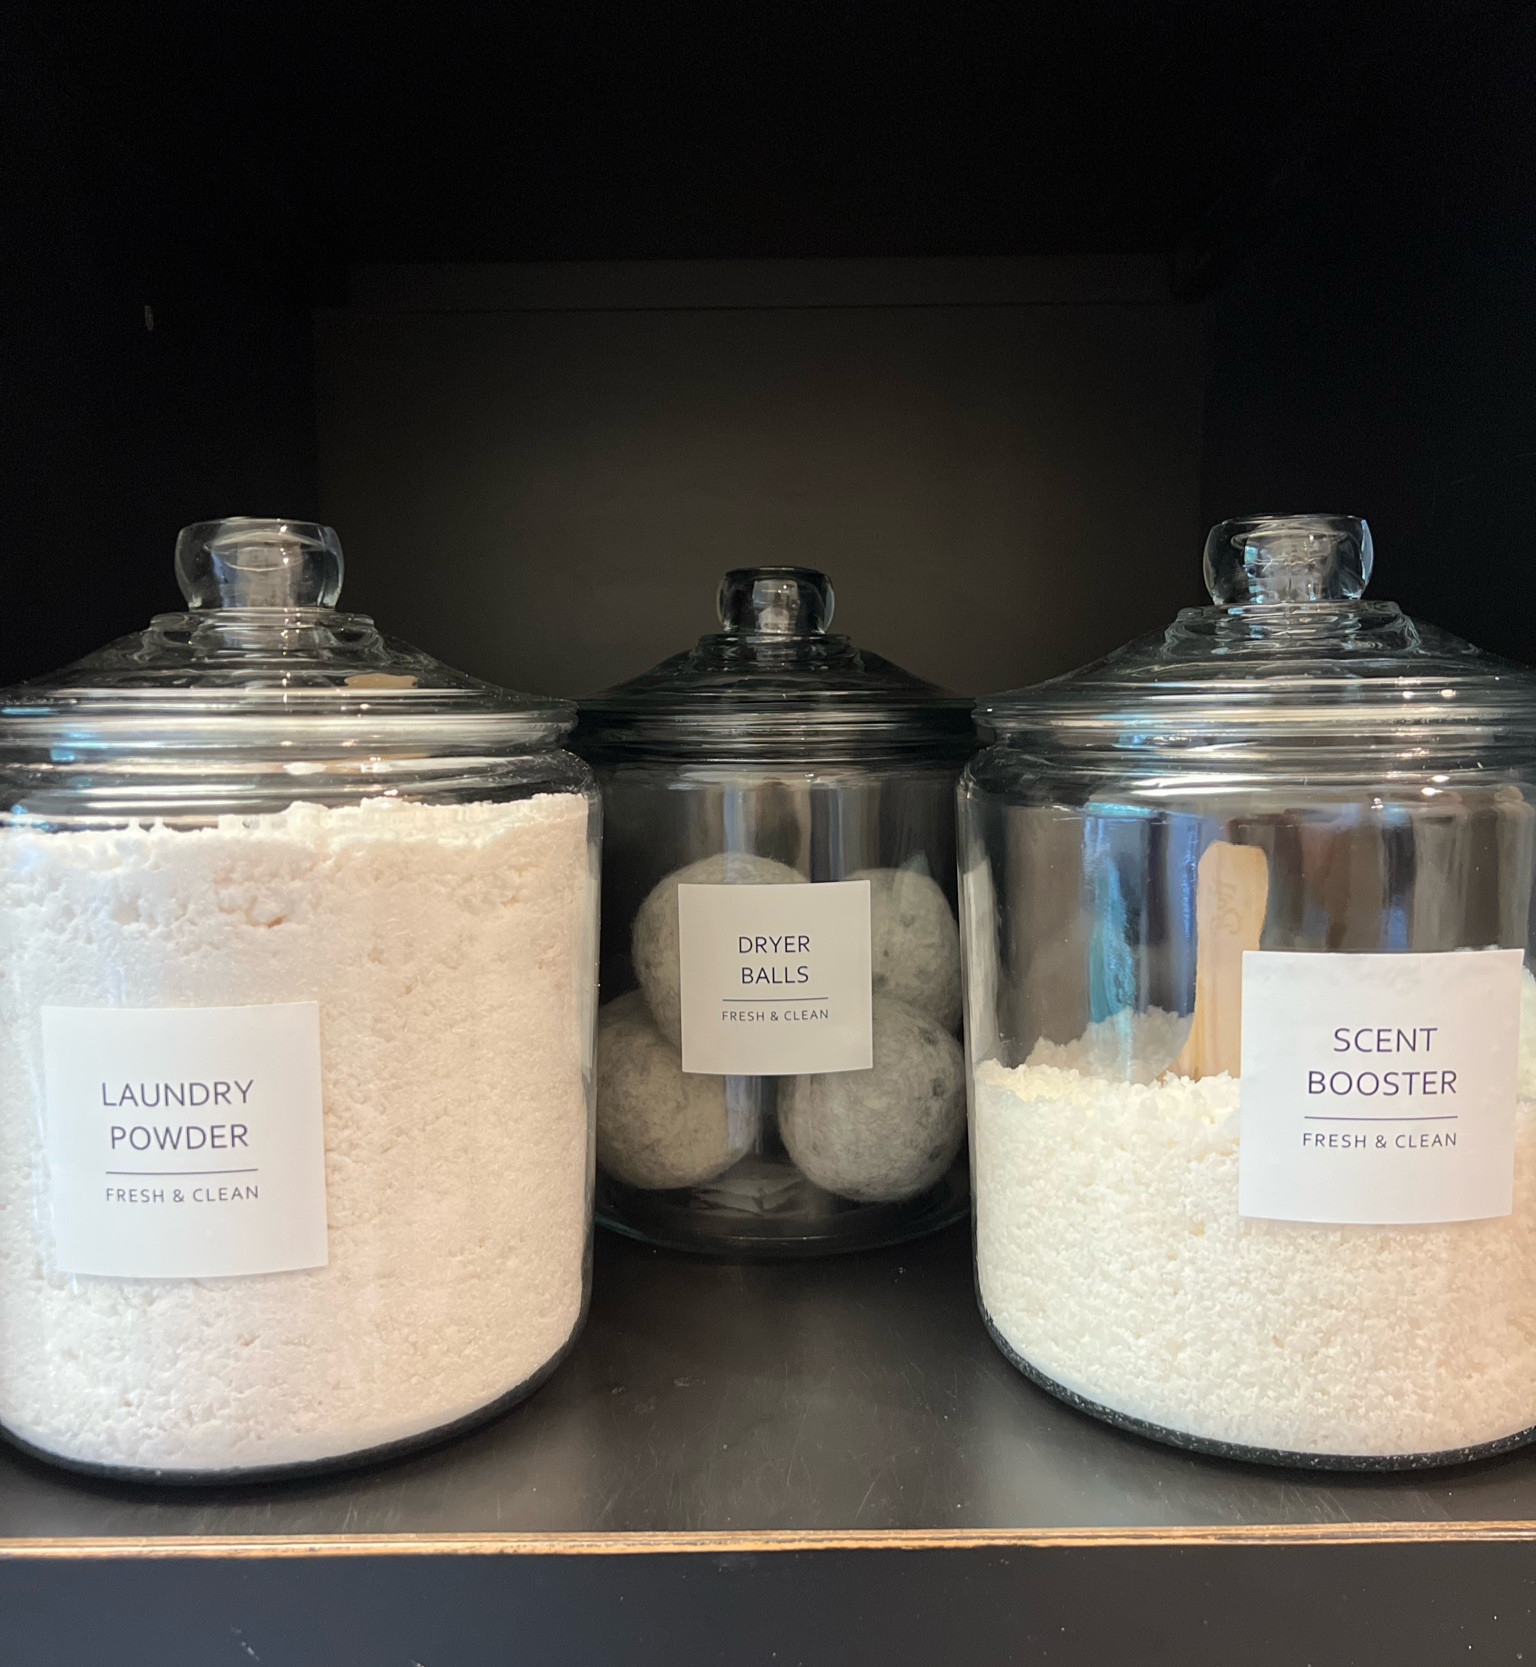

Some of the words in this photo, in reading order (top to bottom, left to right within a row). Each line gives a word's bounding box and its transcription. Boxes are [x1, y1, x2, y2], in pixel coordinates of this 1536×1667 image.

[738, 935, 811, 954] DRYER
[741, 966, 809, 985] BALLS
[722, 1010, 765, 1022] FRESH
[770, 1010, 779, 1022] &
[783, 1008, 829, 1022] CLEAN
[1333, 1027, 1439, 1053] SCENT
[1307, 1070, 1457, 1096] BOOSTER
[101, 1079, 255, 1108] LAUNDRY
[110, 1124, 249, 1151] POWDER
[1302, 1132, 1367, 1149] FRESH
[1374, 1134, 1388, 1149] &
[1394, 1132, 1457, 1149] CLEAN
[105, 1187, 165, 1204] FRESH
[172, 1188, 185, 1204] &
[192, 1184, 259, 1203] CLEAN
